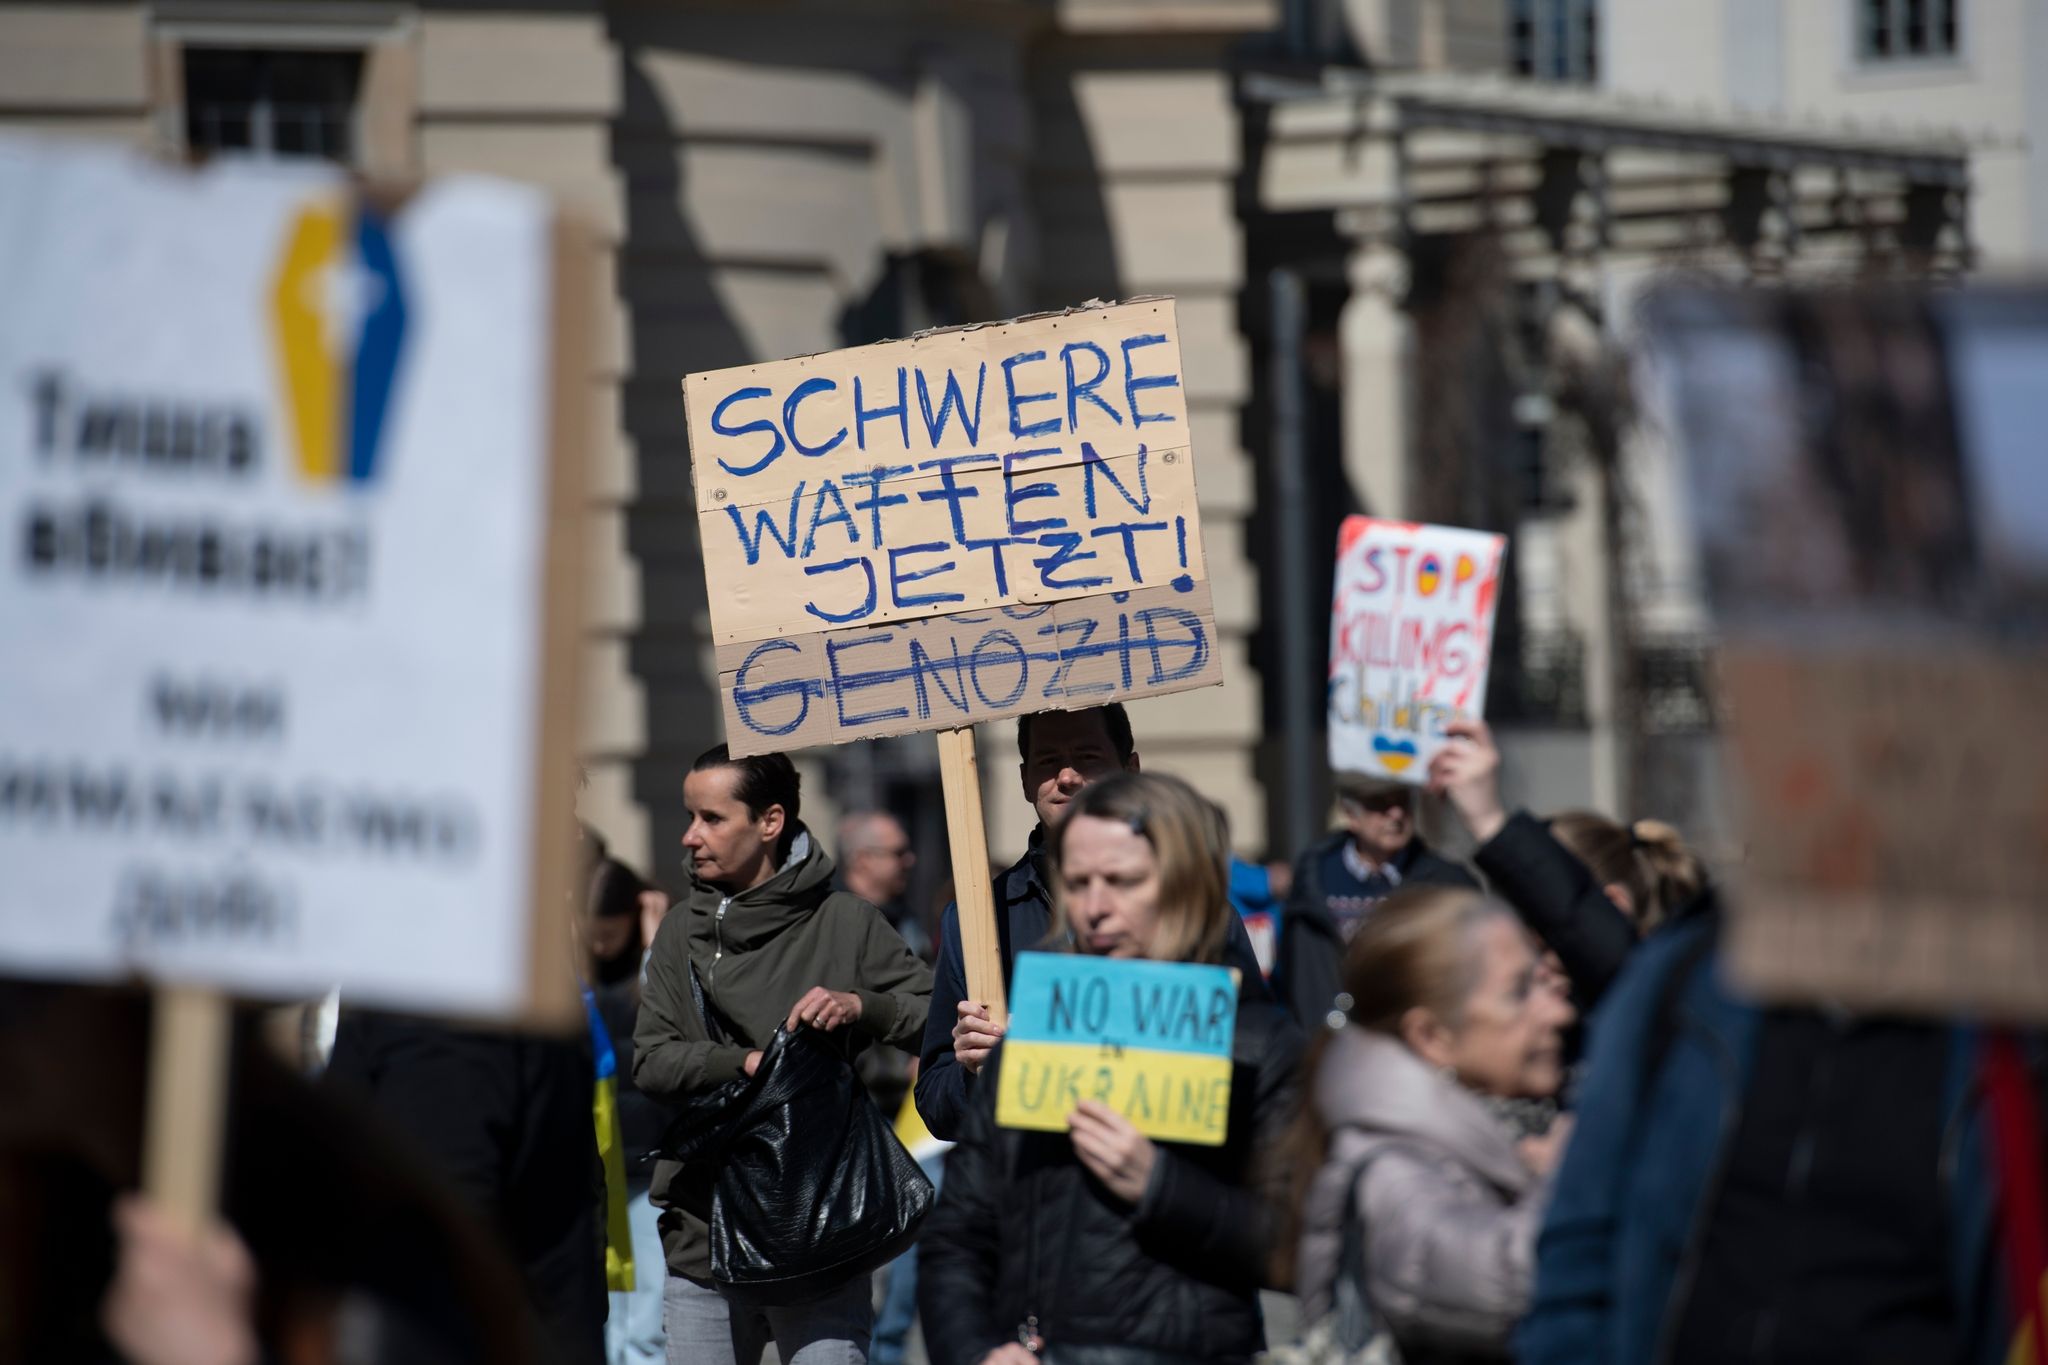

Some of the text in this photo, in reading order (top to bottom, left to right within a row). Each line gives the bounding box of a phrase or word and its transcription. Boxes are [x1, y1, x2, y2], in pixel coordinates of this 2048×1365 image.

[711, 334, 1180, 476] SCHWERE
[727, 442, 1152, 565] WAFFEN
[804, 516, 1196, 623] JETZT!
[1356, 547, 1475, 601] STOP
[734, 606, 1210, 736] GENOZID
[1338, 611, 1469, 677] KILLING
[1049, 976, 1233, 1047] NO WAR
[1017, 1060, 1232, 1132] UKRAINE
